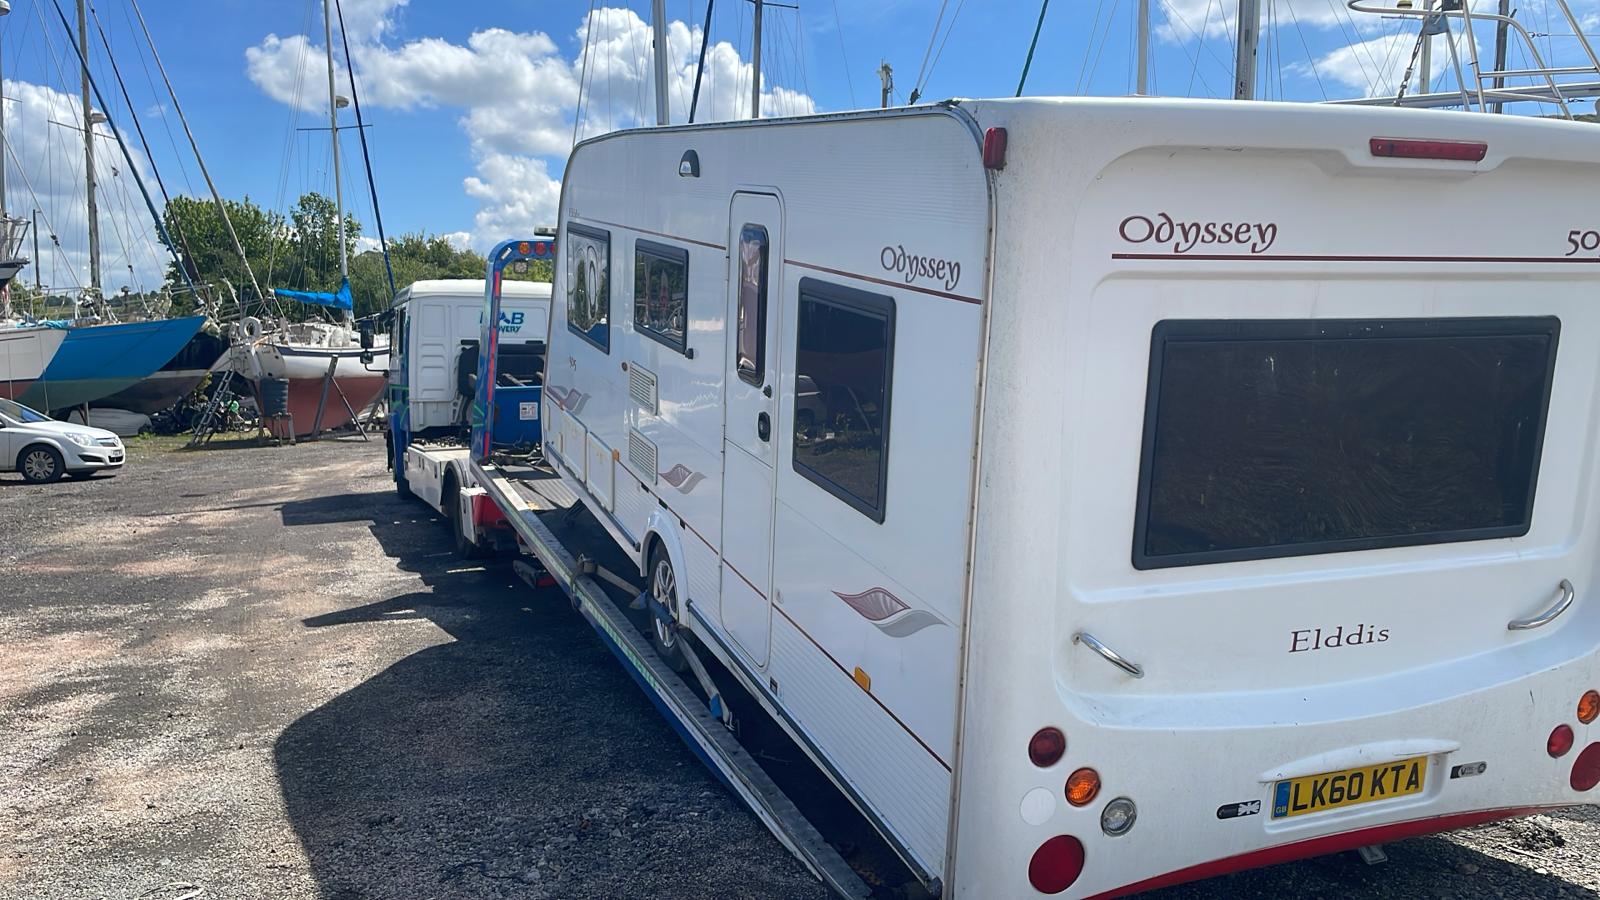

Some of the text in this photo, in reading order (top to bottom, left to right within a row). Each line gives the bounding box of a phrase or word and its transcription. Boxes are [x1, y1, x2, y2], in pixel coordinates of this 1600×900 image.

[1118, 212, 1278, 254] Odyssey
[880, 245, 961, 292] Odyssey
[1288, 623, 1390, 653] Elddis
[1292, 762, 1420, 812] LK60 KTA
